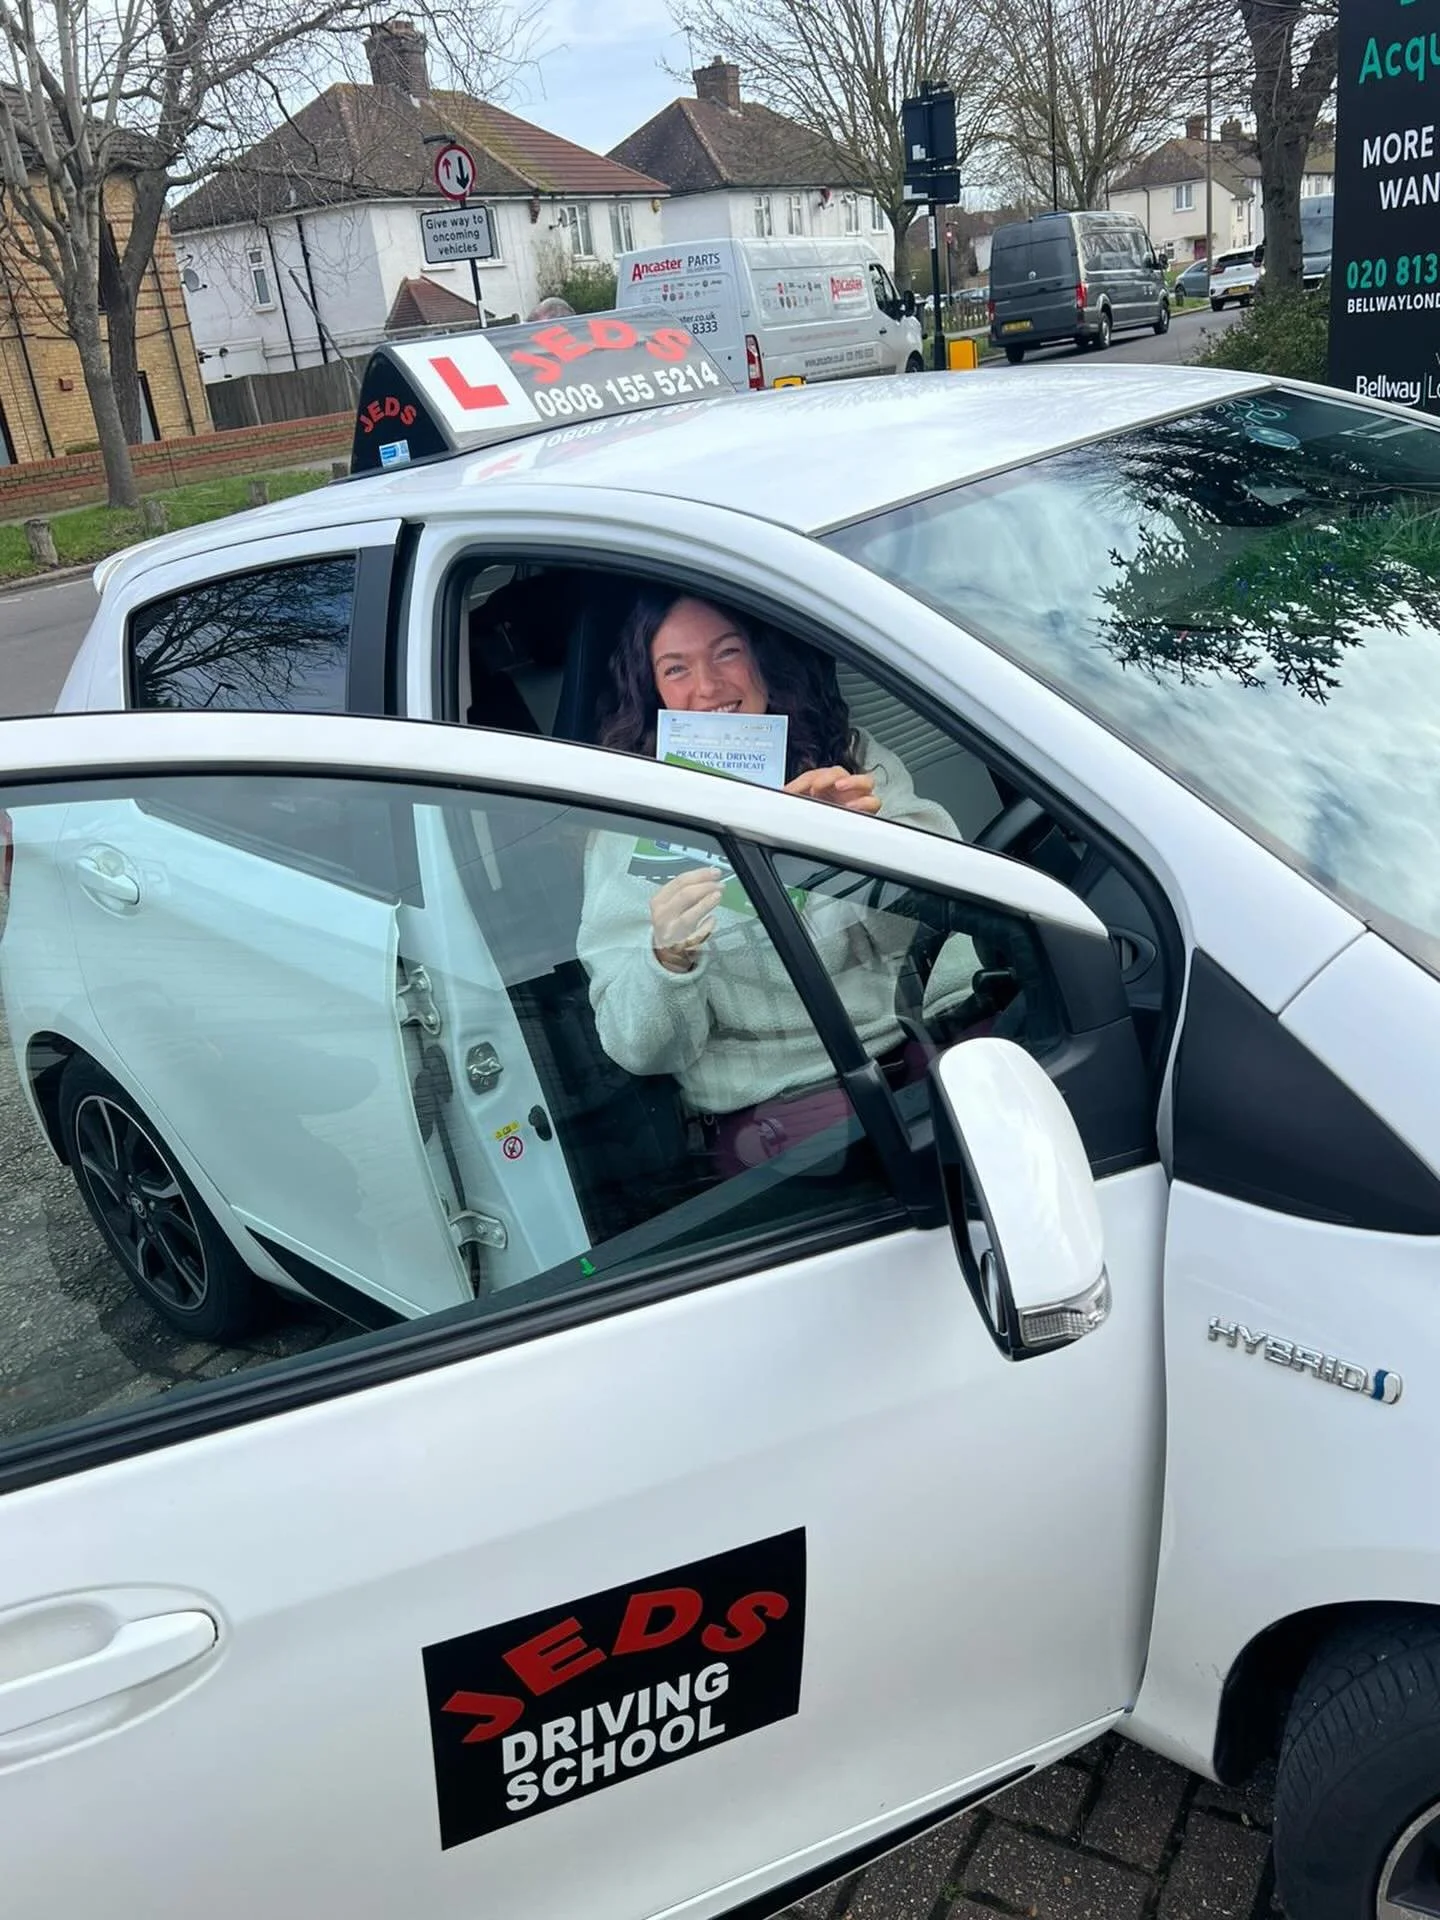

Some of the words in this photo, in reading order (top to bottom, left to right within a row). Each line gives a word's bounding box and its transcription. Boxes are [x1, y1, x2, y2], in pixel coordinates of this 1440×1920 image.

[1359, 33, 1440, 84] Acqu
[1362, 125, 1434, 168] MORE
[1379, 172, 1440, 210] WAN
[426, 219, 447, 229] Give
[450, 217, 469, 227] way
[473, 215, 484, 224] to
[432, 229, 480, 242] oncoming
[438, 242, 478, 255] vehicles
[631, 258, 683, 282] Ancaster
[688, 252, 720, 267] PARTS
[1346, 258, 1388, 289] 020
[1396, 253, 1438, 286] 813
[692, 321, 718, 334] 8333
[511, 318, 692, 384] JEDS
[428, 357, 510, 410] L
[534, 384, 602, 418] 0808
[605, 372, 656, 406] 155
[661, 361, 720, 397] 5214
[1355, 374, 1421, 406] Bellway
[360, 396, 417, 433] JEDS
[676, 750, 723, 760] PRACTICAL
[726, 752, 766, 762] DRIVING
[716, 761, 765, 771] CERTIFICATE
[1208, 1316, 1369, 1392] HYBRID
[440, 1587, 789, 1743] JEDS
[502, 1662, 729, 1774] DRIVING
[505, 1707, 726, 1812] SCHOOL
